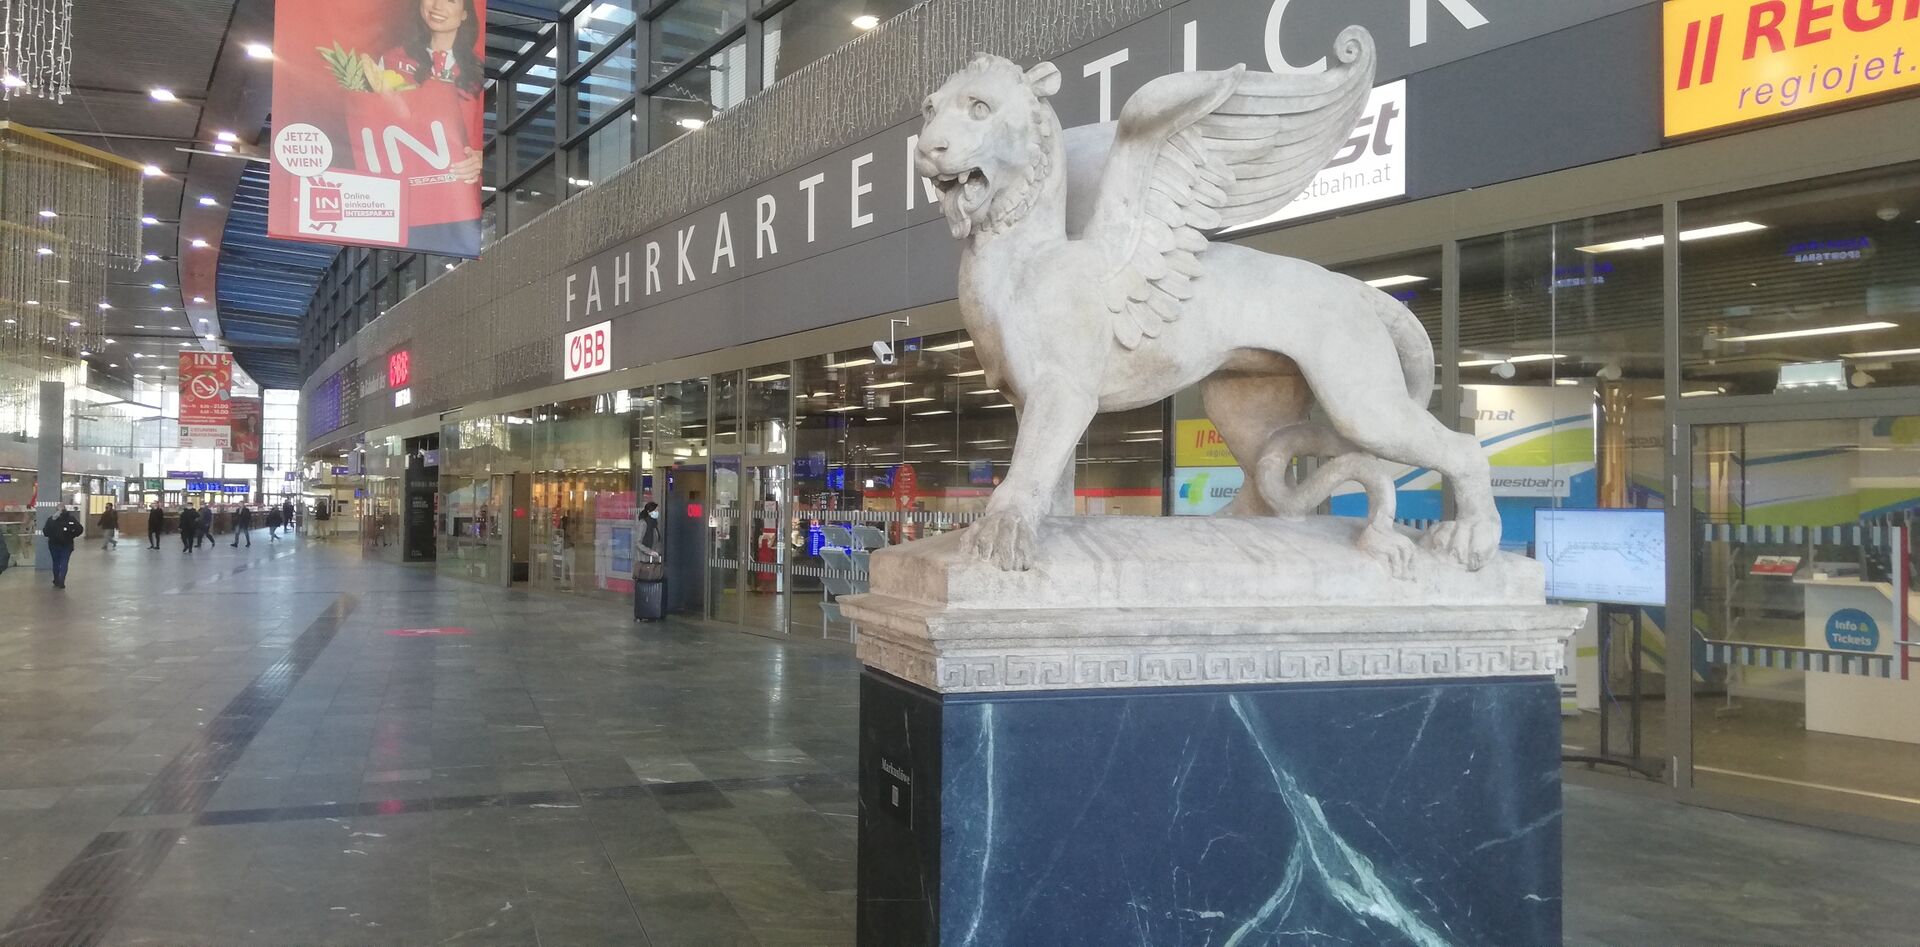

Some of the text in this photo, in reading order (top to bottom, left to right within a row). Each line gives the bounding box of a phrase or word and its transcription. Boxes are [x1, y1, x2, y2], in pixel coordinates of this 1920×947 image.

[284, 132, 320, 141] JETZT
[282, 145, 324, 155] NEU IN
[362, 120, 451, 174] IN
[286, 158, 322, 168] WIEN!
[1293, 163, 1391, 202] stbahn.at
[343, 192, 370, 200] Online
[315, 196, 339, 209] IN
[344, 200, 386, 208] einkaufen
[570, 329, 605, 372] ÖBB
[194, 353, 217, 365] IN
[1476, 408, 1518, 421] n.at
[1490, 477, 1565, 489] westbahn
[1835, 620, 1858, 632] Info
[1832, 632, 1872, 647] Tickets
